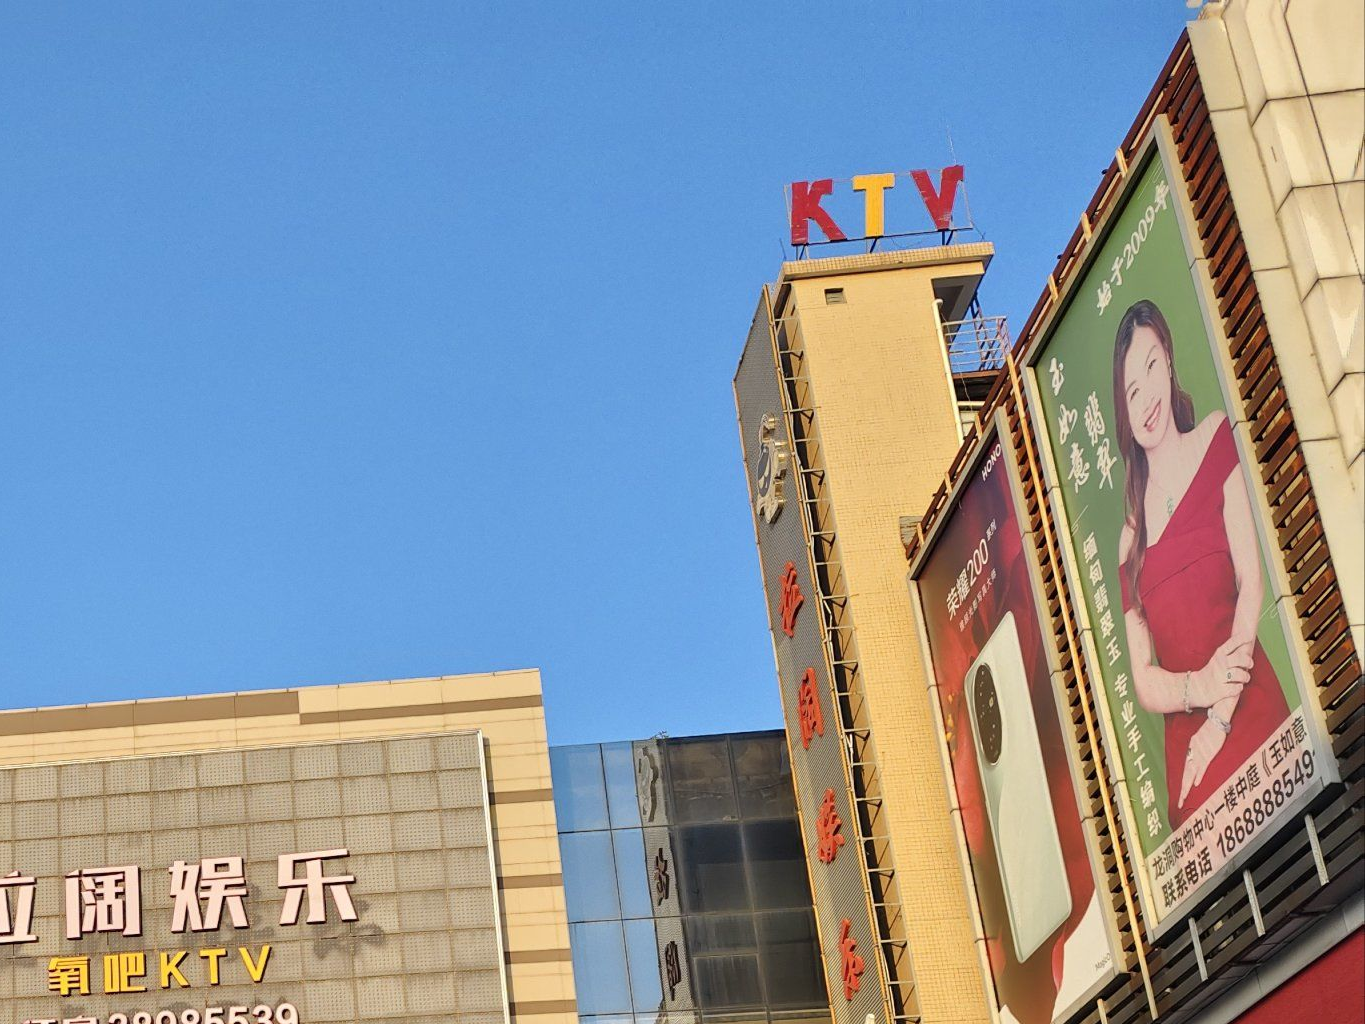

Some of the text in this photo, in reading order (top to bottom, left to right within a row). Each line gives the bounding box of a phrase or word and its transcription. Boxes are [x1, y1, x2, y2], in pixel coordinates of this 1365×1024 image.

[791, 165, 964, 246] KTV
[1097, 180, 1169, 315] 始于2009年
[1114, 672, 1162, 838] 专业手工编织
[1161, 750, 1316, 909] 联系电话 1868888549
